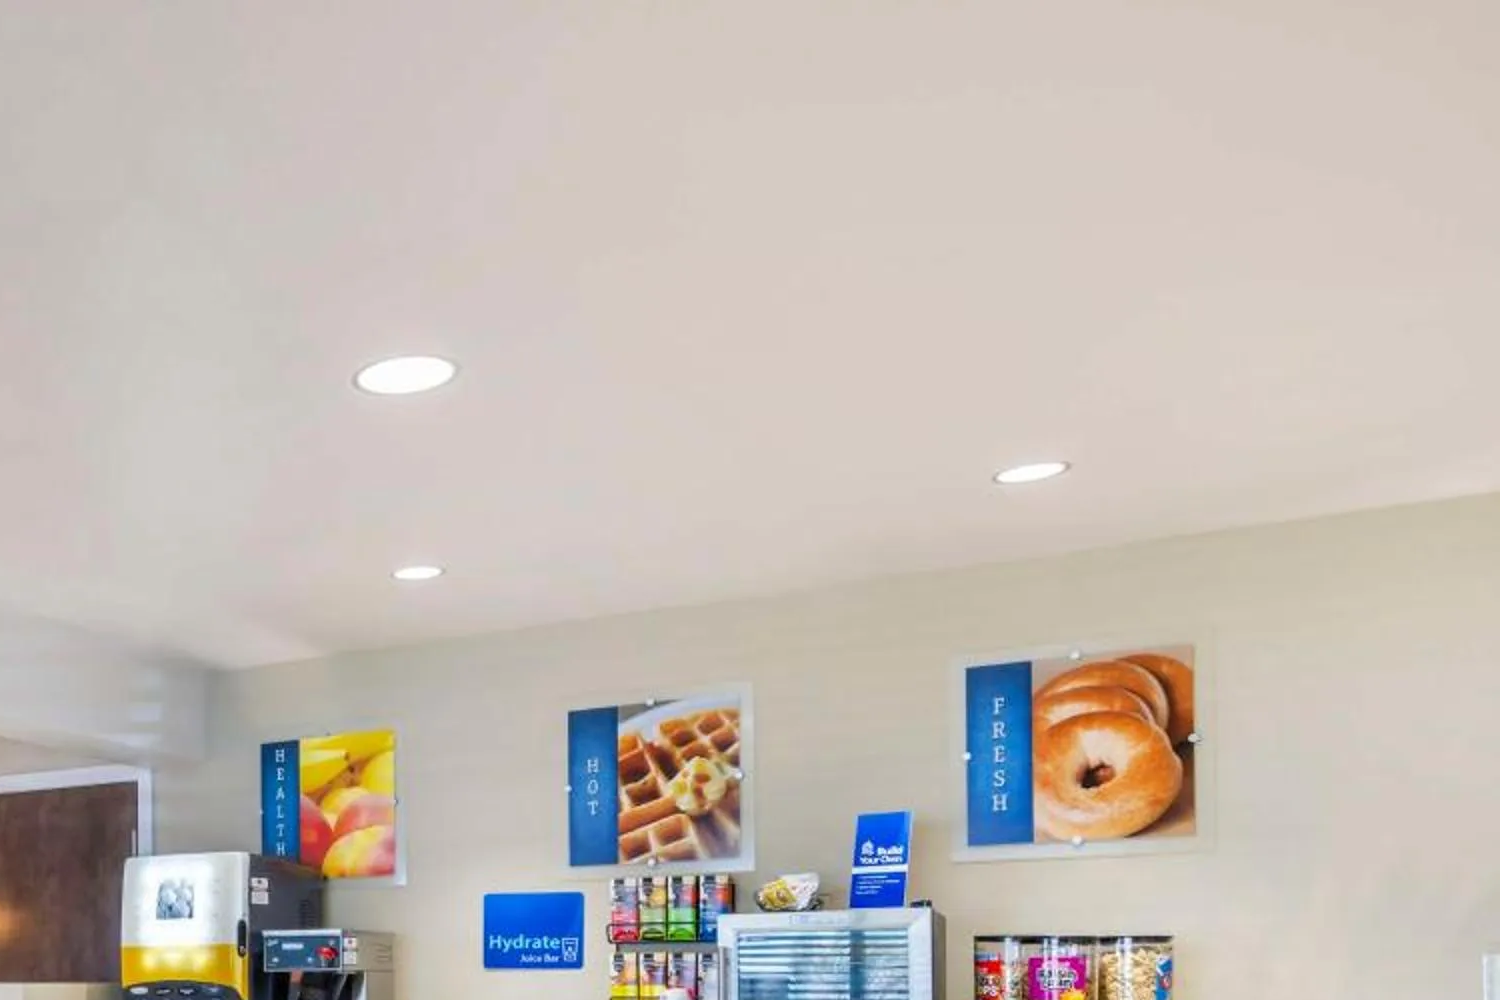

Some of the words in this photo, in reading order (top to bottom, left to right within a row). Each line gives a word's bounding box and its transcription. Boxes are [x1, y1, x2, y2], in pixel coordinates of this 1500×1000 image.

[992, 697, 1008, 812] FRESH
[275, 749, 286, 857] HEALTH
[587, 758, 599, 816] HOT
[488, 934, 561, 953] Hydrate
[544, 953, 560, 963] Bar
